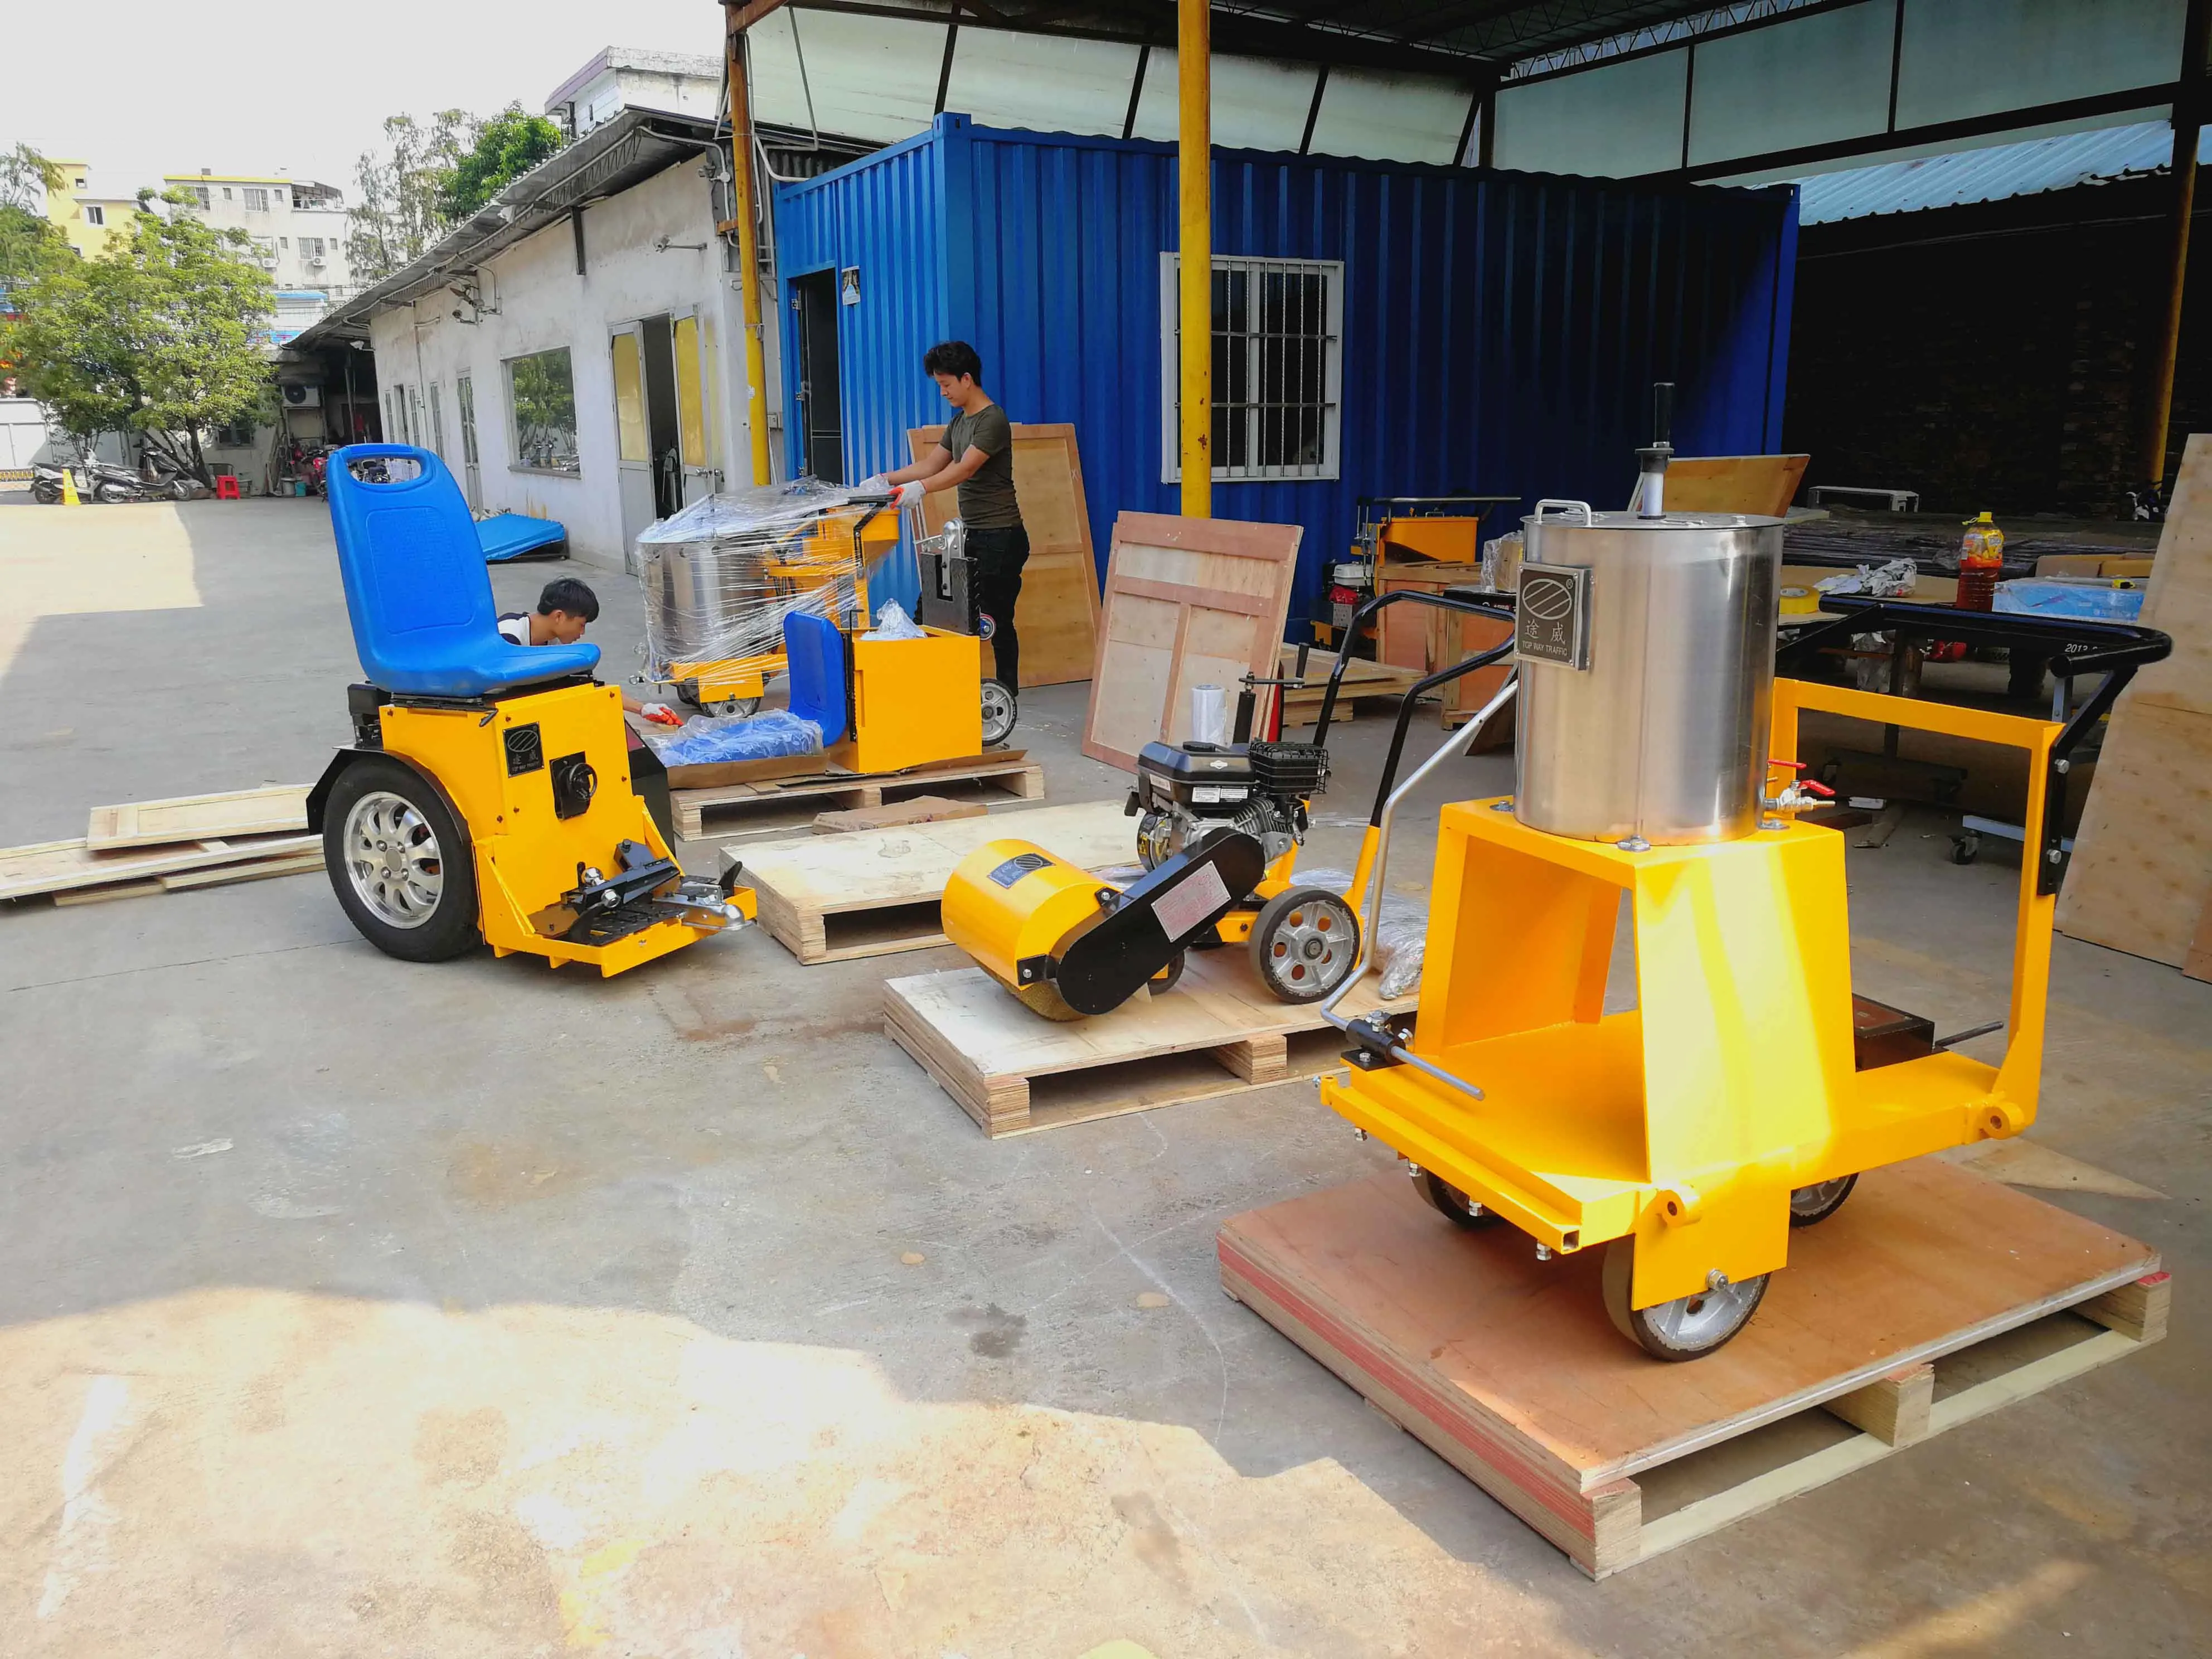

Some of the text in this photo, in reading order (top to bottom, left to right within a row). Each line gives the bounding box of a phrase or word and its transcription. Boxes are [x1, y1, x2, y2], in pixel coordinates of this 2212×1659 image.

[1522, 640, 1568, 656] TOP WAY TRAFFIC
